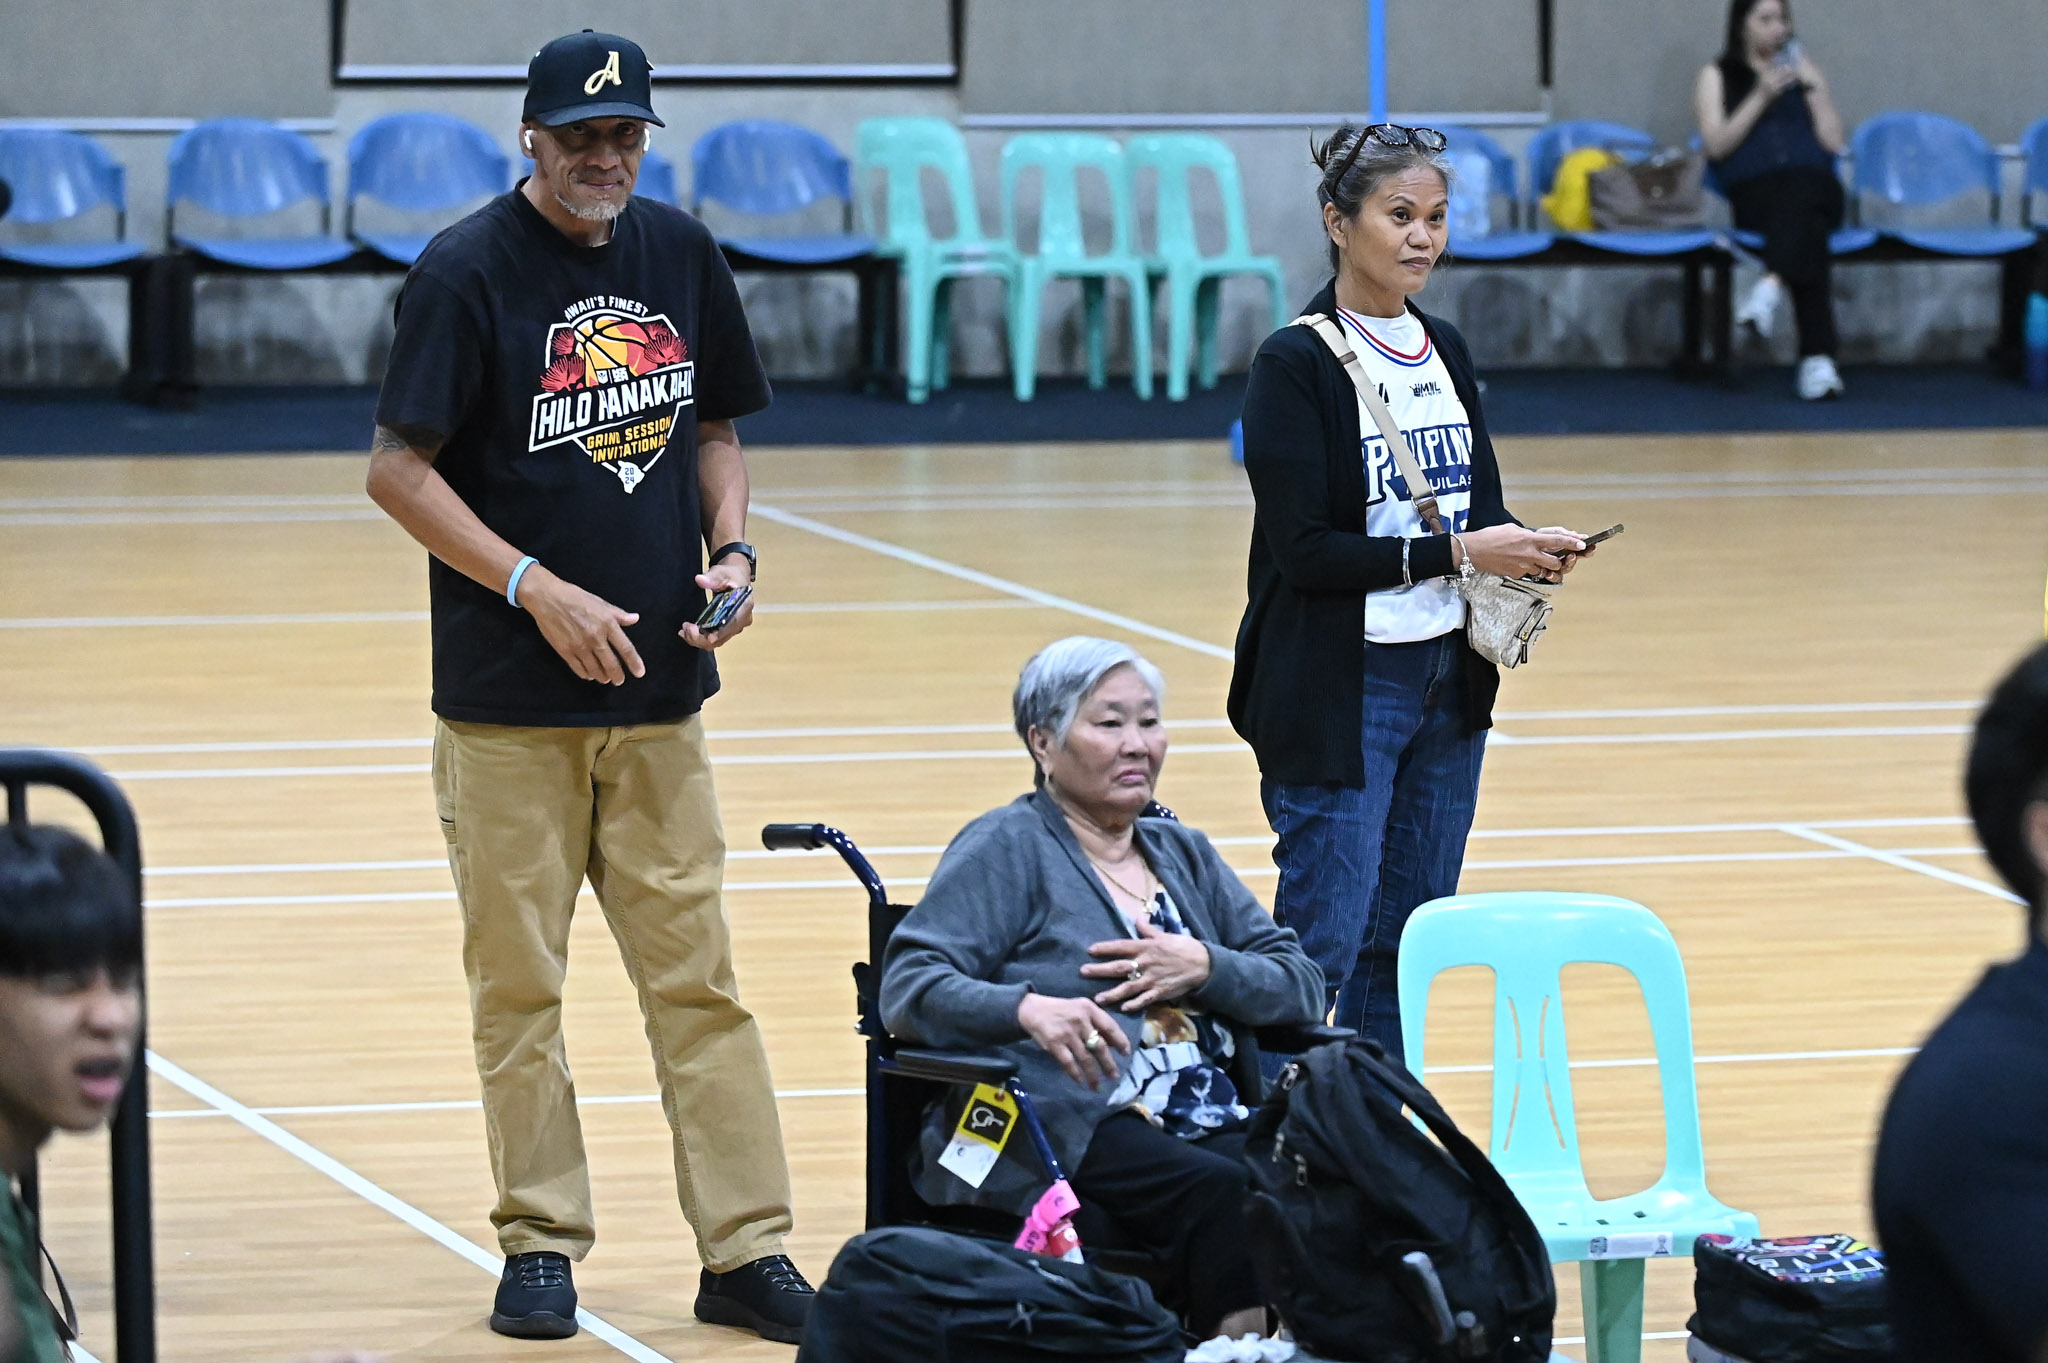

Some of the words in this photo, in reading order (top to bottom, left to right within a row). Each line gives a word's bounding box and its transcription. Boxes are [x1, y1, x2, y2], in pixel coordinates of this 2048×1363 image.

[584, 50, 622, 96] A
[608, 295, 649, 317] FINEST
[538, 391, 592, 440] HILO
[624, 416, 672, 442] SESSION
[592, 432, 668, 463] INVITATIONAL
[624, 467, 635, 476] 20
[624, 476, 635, 485] 24
